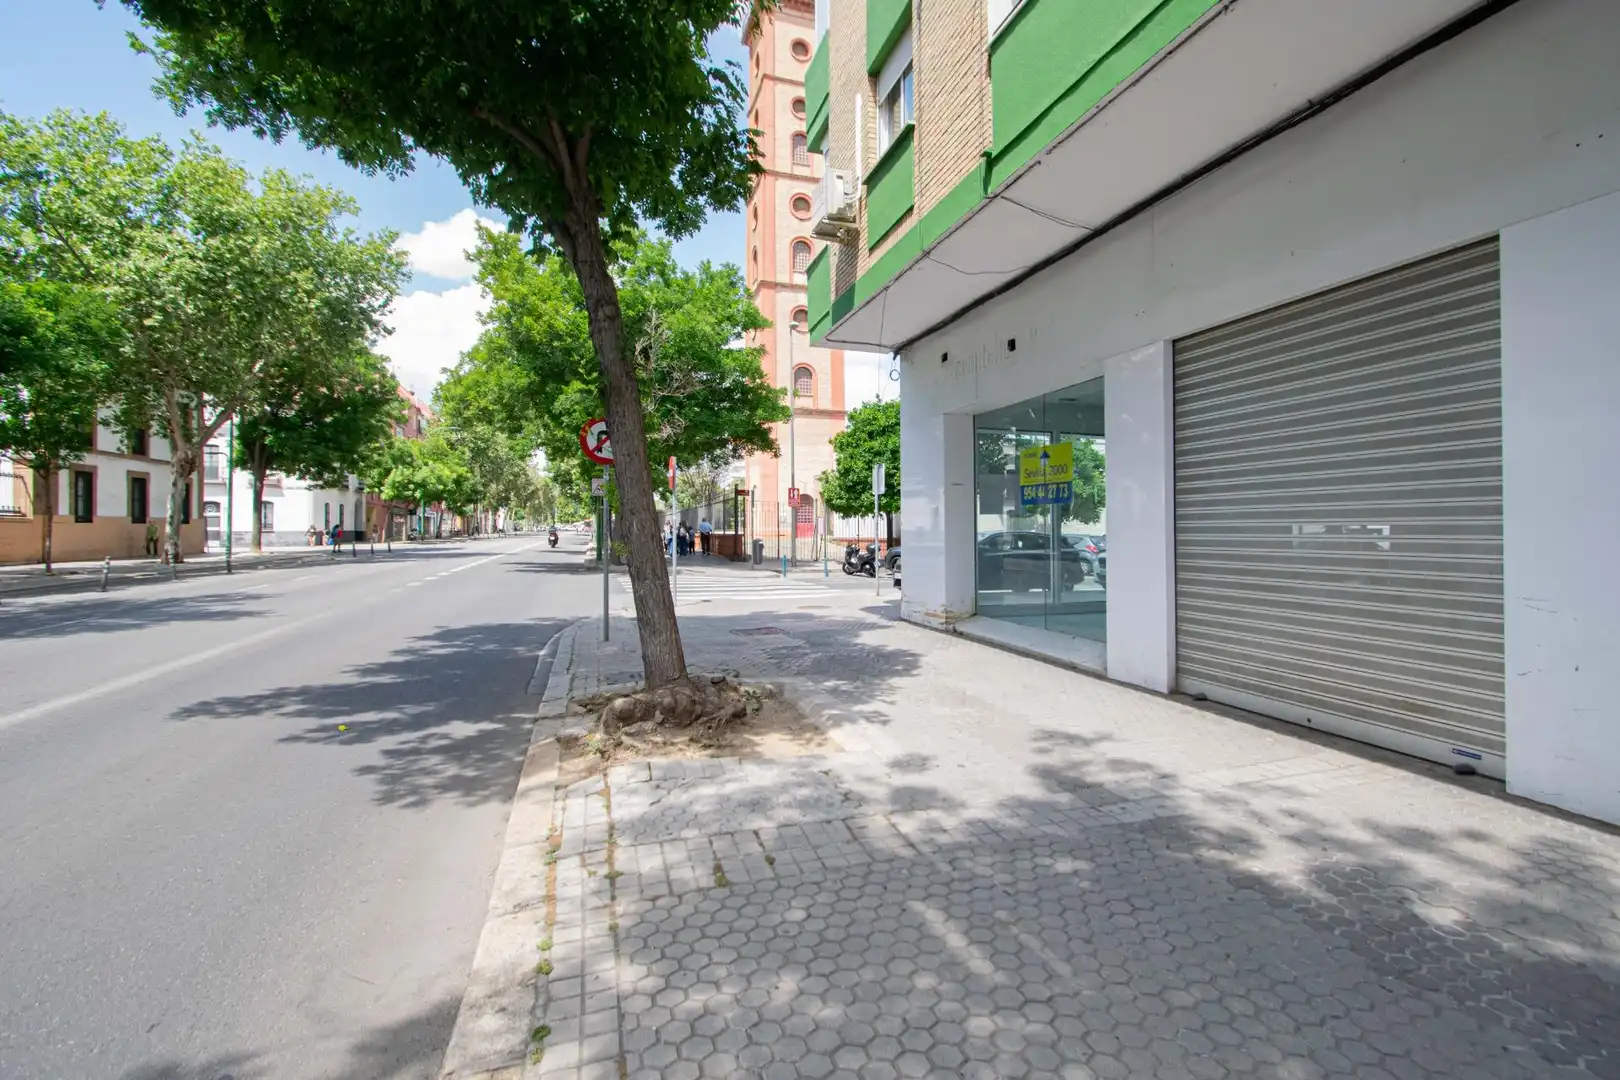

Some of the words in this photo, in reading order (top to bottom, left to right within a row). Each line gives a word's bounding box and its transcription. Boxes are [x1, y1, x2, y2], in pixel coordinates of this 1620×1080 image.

[1048, 463, 1068, 476] 2000
[1024, 486, 1036, 500] 954
[1047, 483, 1057, 499] 27
[1059, 483, 1068, 498] 73
